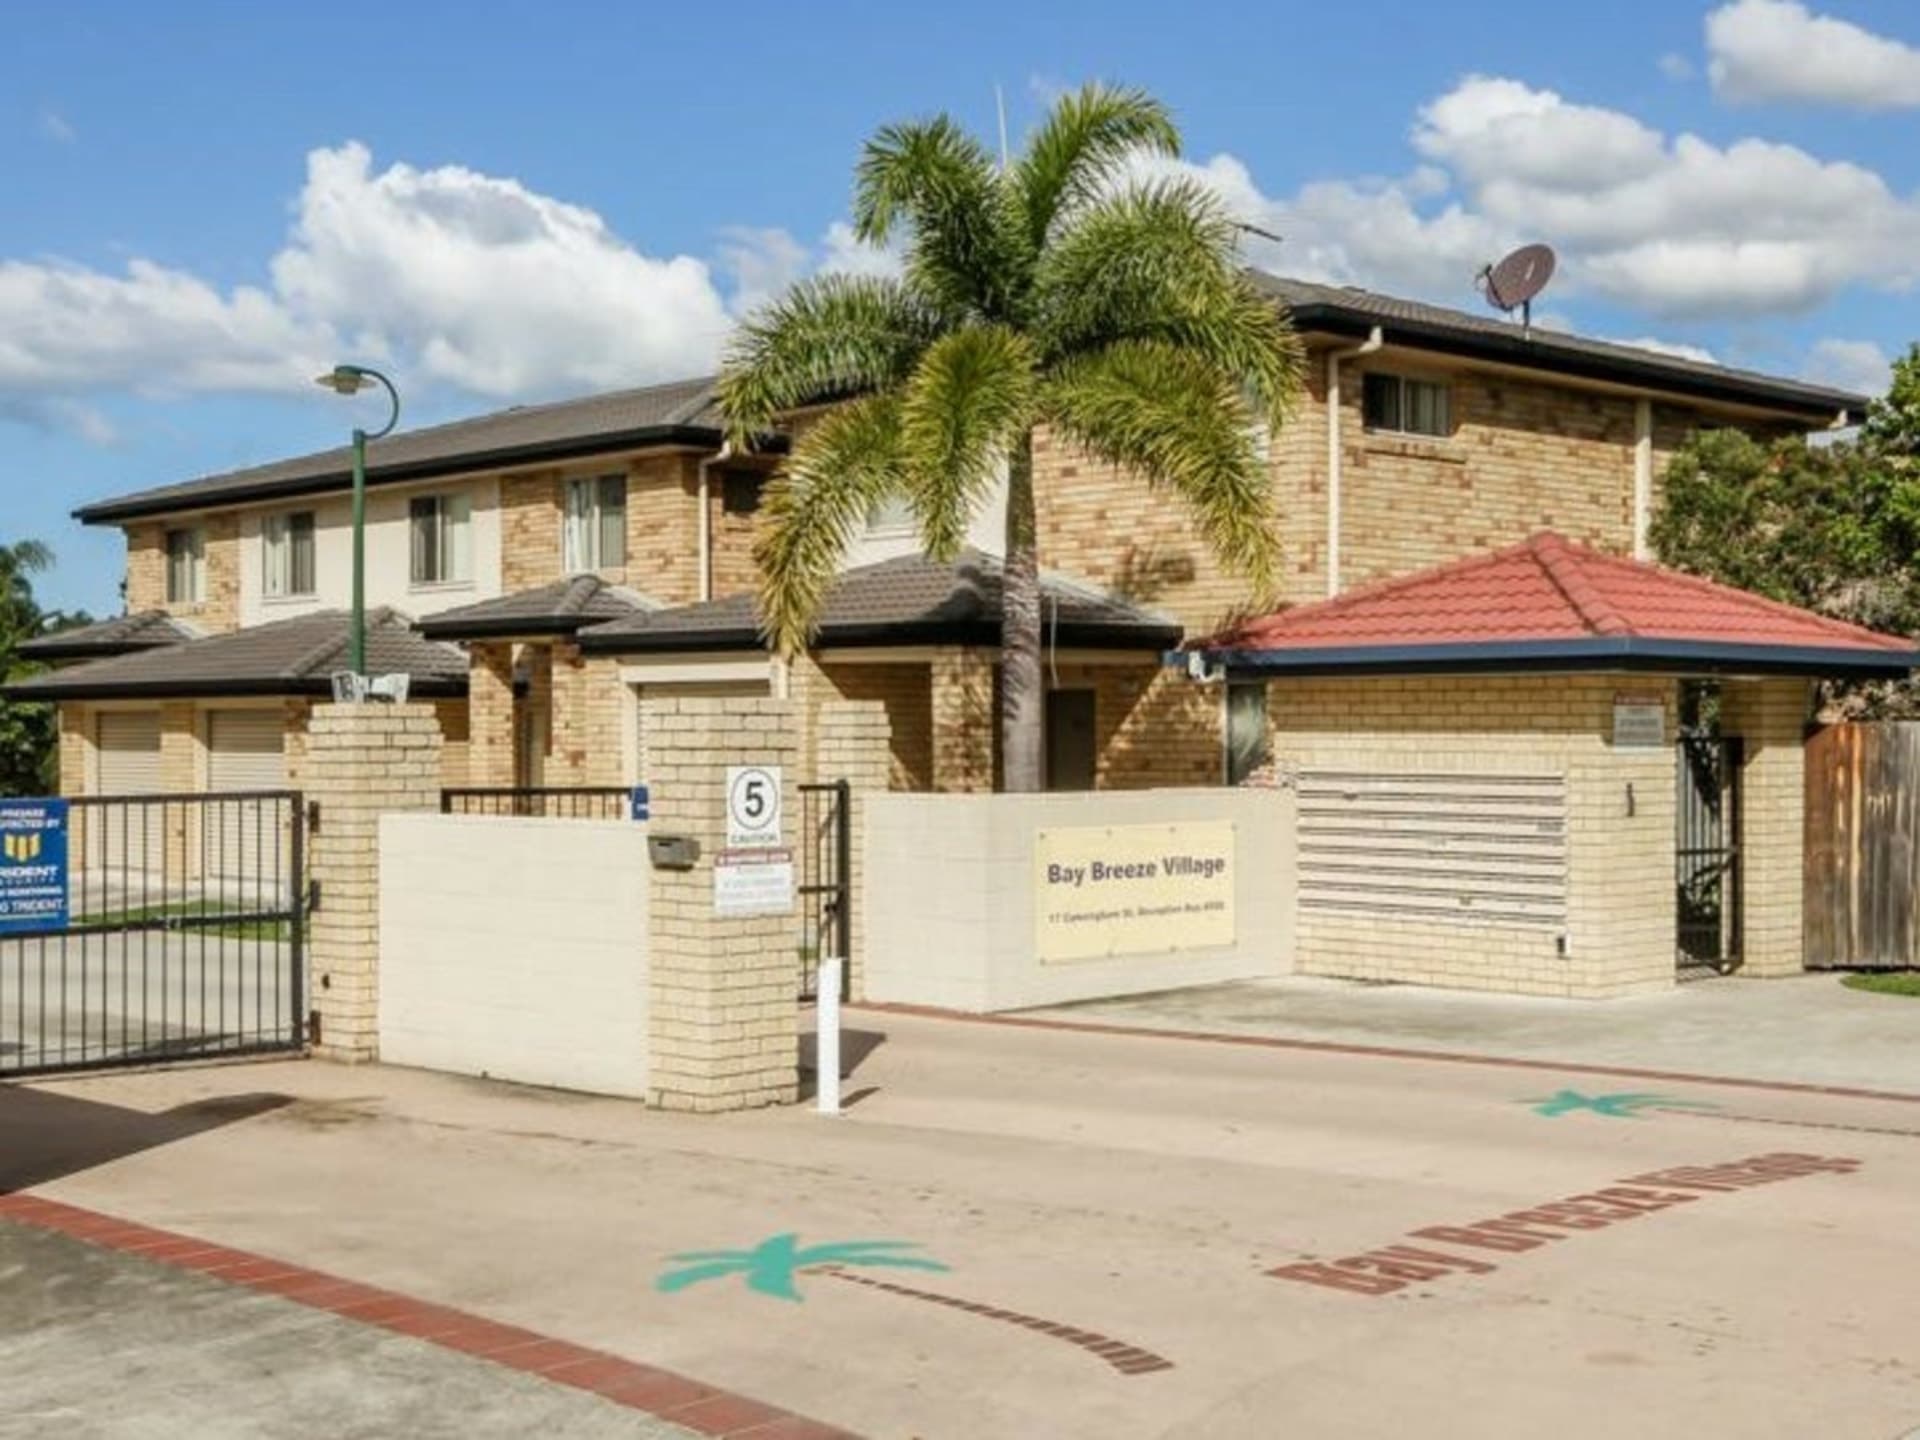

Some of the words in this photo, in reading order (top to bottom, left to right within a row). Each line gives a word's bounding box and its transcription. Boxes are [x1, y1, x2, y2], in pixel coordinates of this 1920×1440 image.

[745, 781, 764, 817] 5
[1047, 863, 1085, 887] Bay
[1091, 861, 1157, 881] Breeze
[1163, 855, 1225, 878] Village
[1264, 1245, 1497, 1296] Bay
[1405, 1187, 1700, 1252] Breeze
